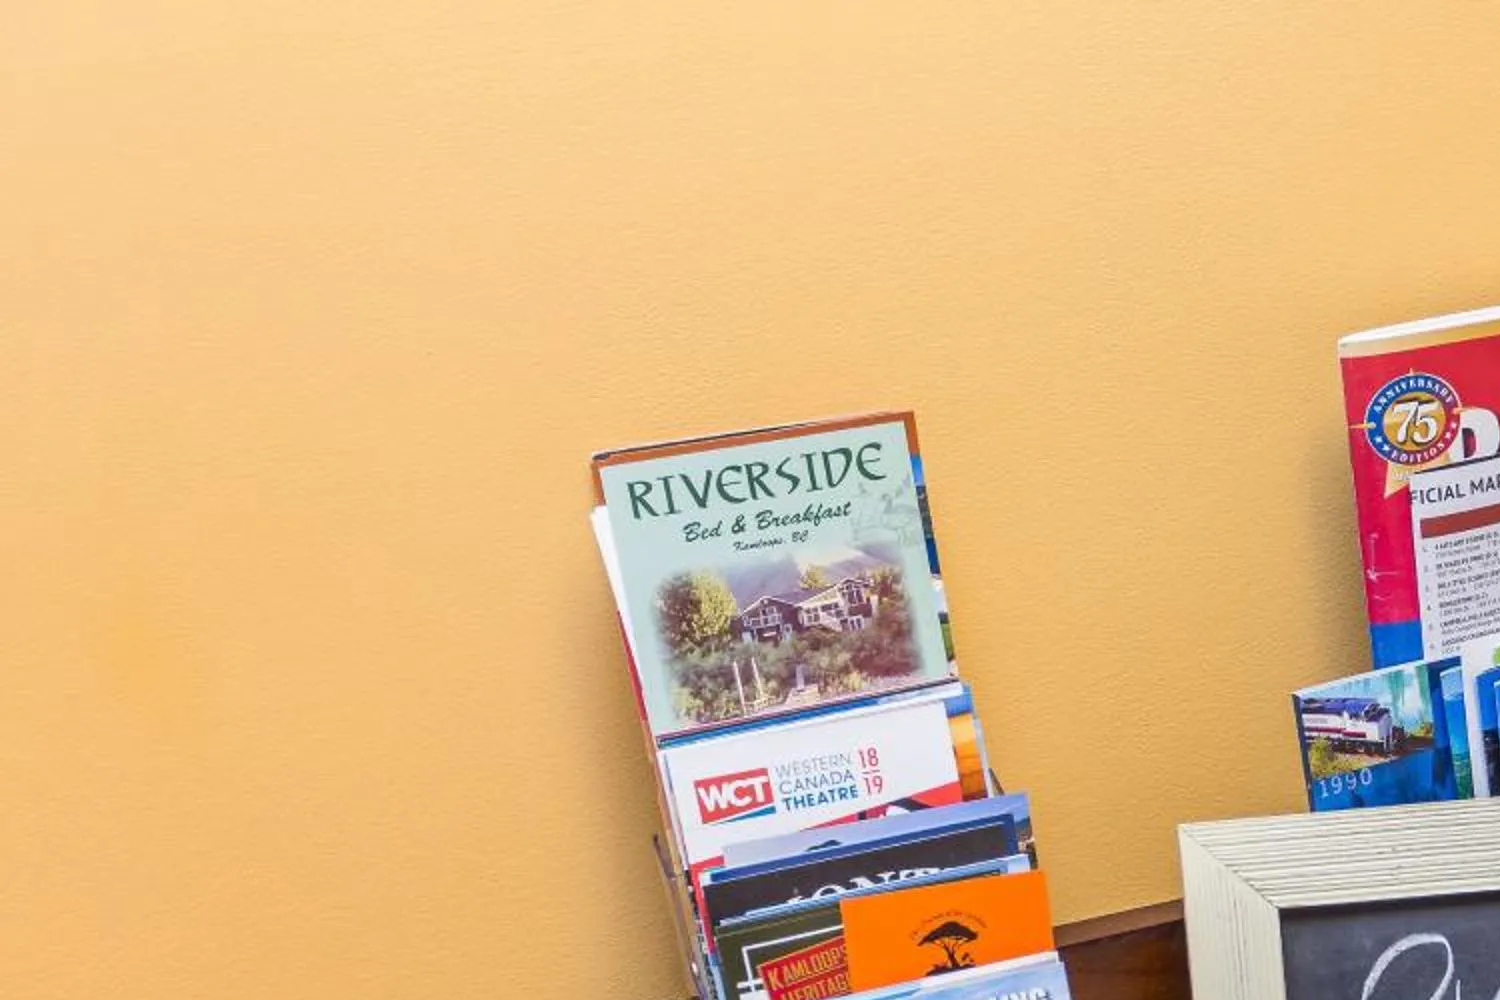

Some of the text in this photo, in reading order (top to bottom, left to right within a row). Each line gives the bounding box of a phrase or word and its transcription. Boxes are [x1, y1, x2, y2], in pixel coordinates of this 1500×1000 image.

[1373, 378, 1454, 414] ANNIVERSARY
[1393, 401, 1438, 443] 75
[1391, 443, 1445, 463] EDITION
[625, 441, 887, 520] RIVERSIDE
[683, 501, 853, 544] Bed & Breakfast
[775, 747, 879, 777] WESTERN 18
[696, 777, 769, 814] WCT
[779, 768, 883, 797] CANADA 19
[781, 784, 859, 812] THEATRE
[1318, 767, 1373, 799] 1990
